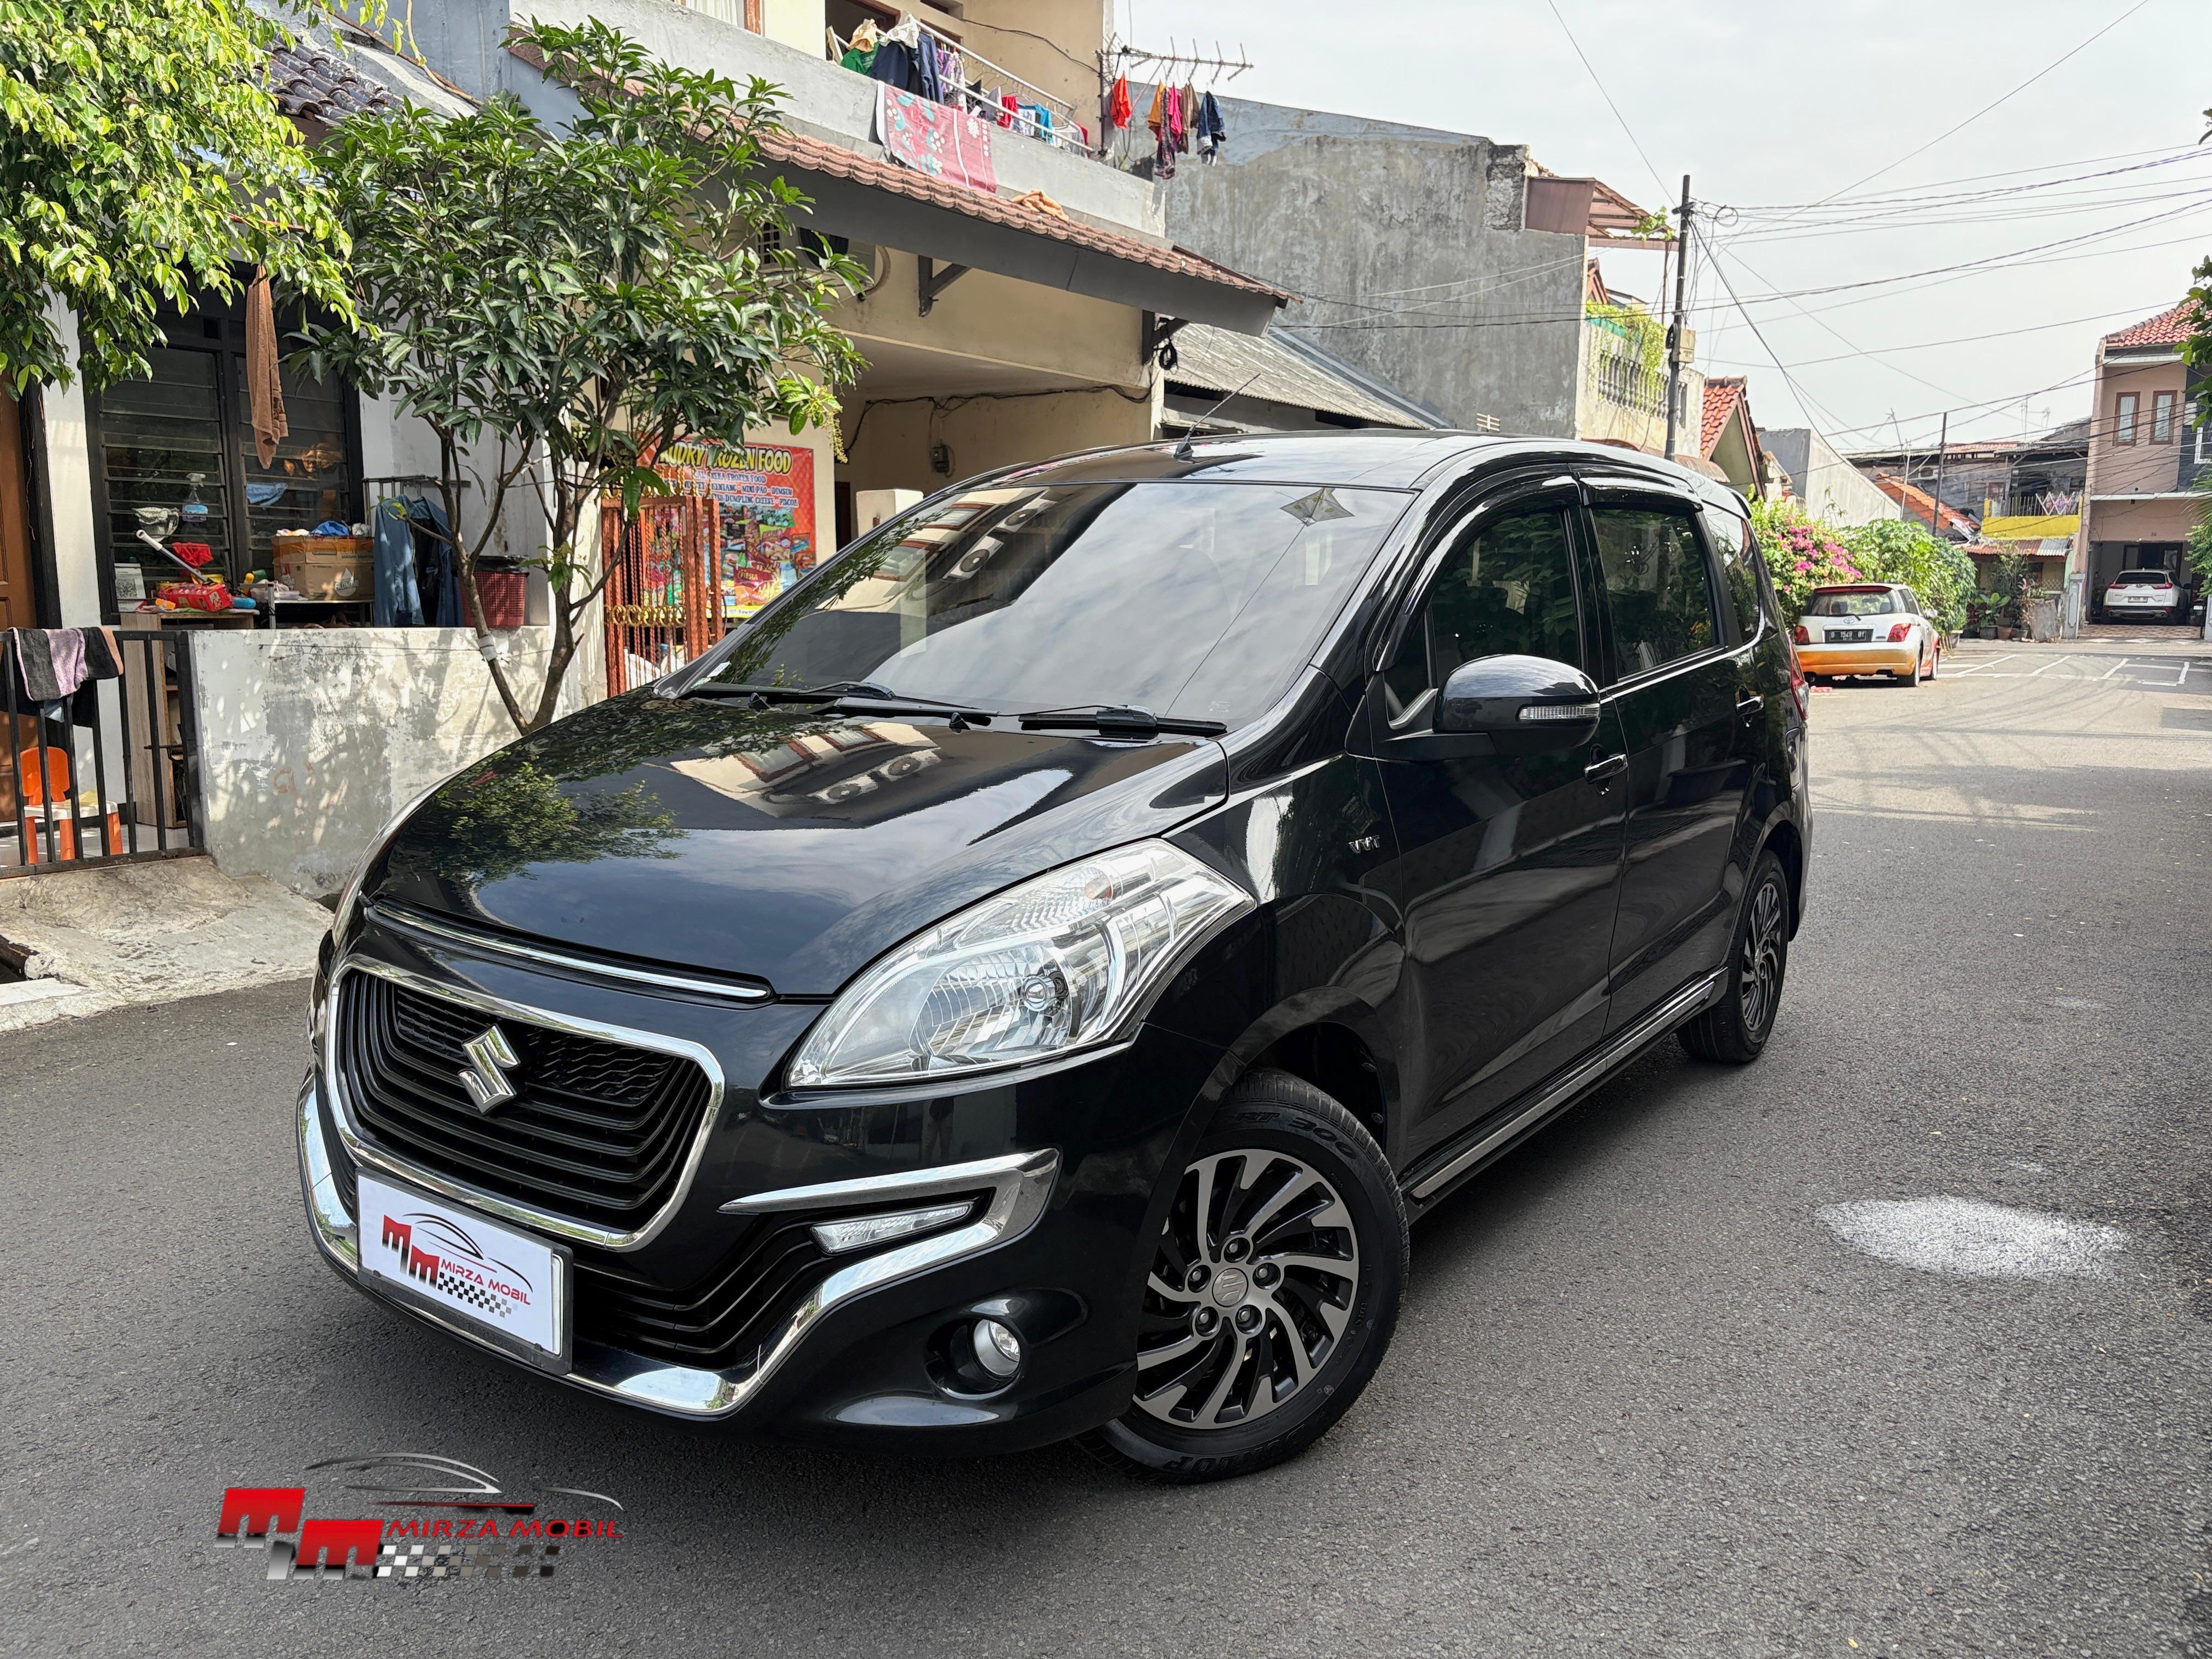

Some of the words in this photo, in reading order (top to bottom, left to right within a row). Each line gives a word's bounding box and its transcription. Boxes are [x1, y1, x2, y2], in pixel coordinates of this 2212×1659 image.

[757, 447, 793, 475] FOOD
[727, 472, 750, 482] FROZEN
[751, 474, 766, 483] FOOD
[441, 1259, 484, 1286] MIRZA
[488, 1279, 532, 1306] MOBIL
